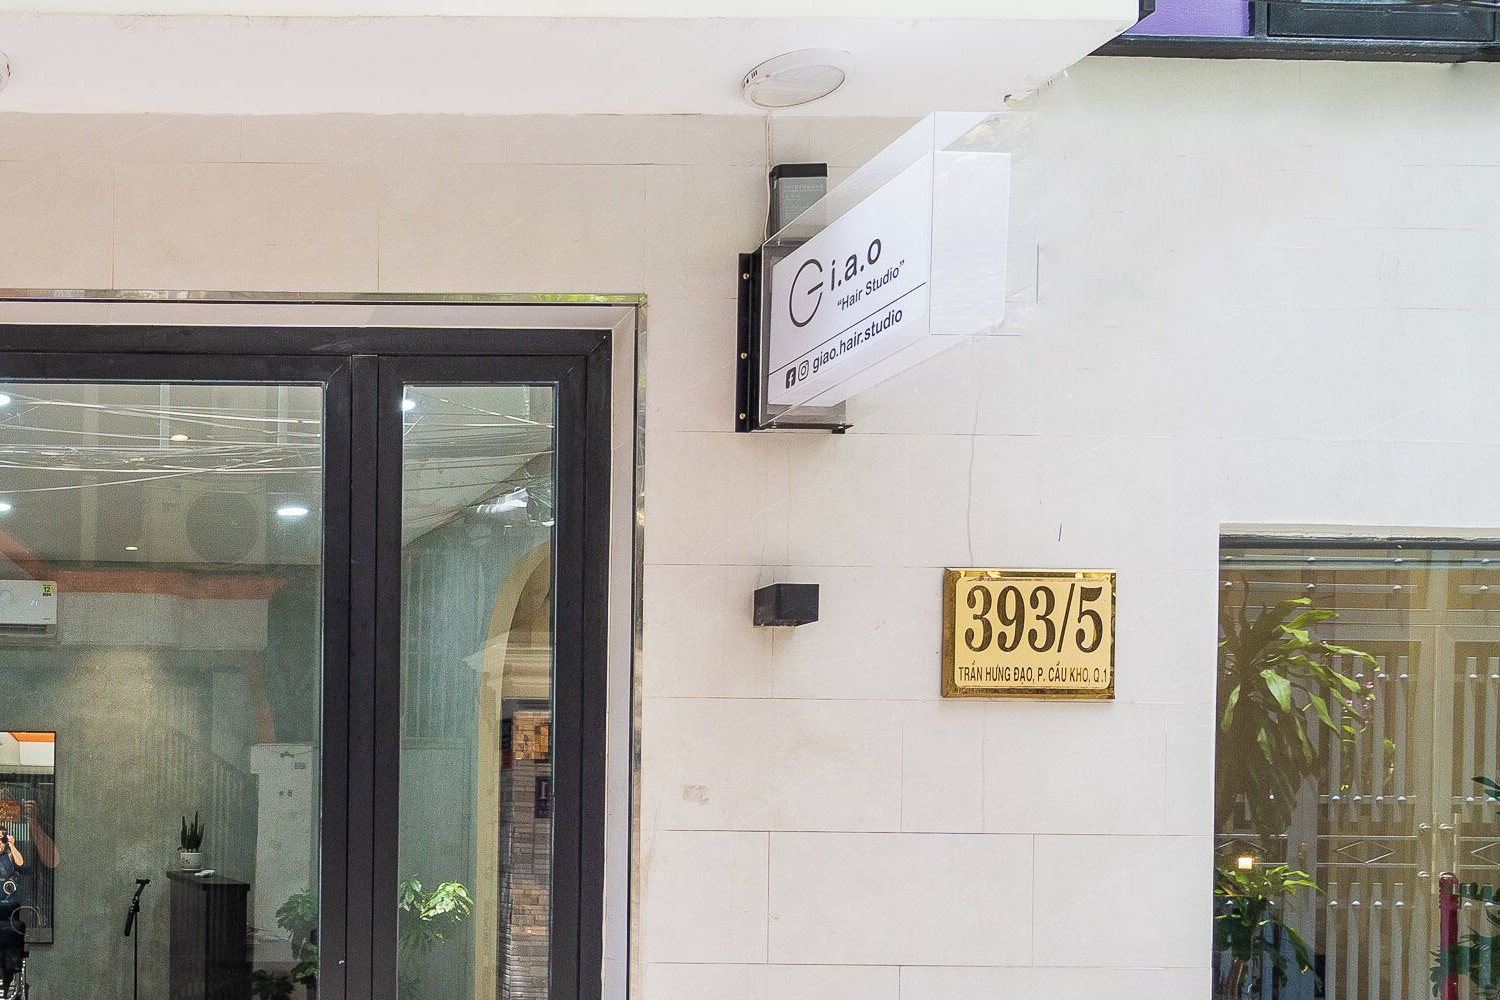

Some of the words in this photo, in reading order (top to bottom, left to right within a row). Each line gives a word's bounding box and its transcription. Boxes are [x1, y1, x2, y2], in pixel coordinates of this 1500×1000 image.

[812, 309, 903, 373] giao.hair.studio
[964, 583, 1103, 654] 393/5
[986, 664, 1011, 681] HƯNG
